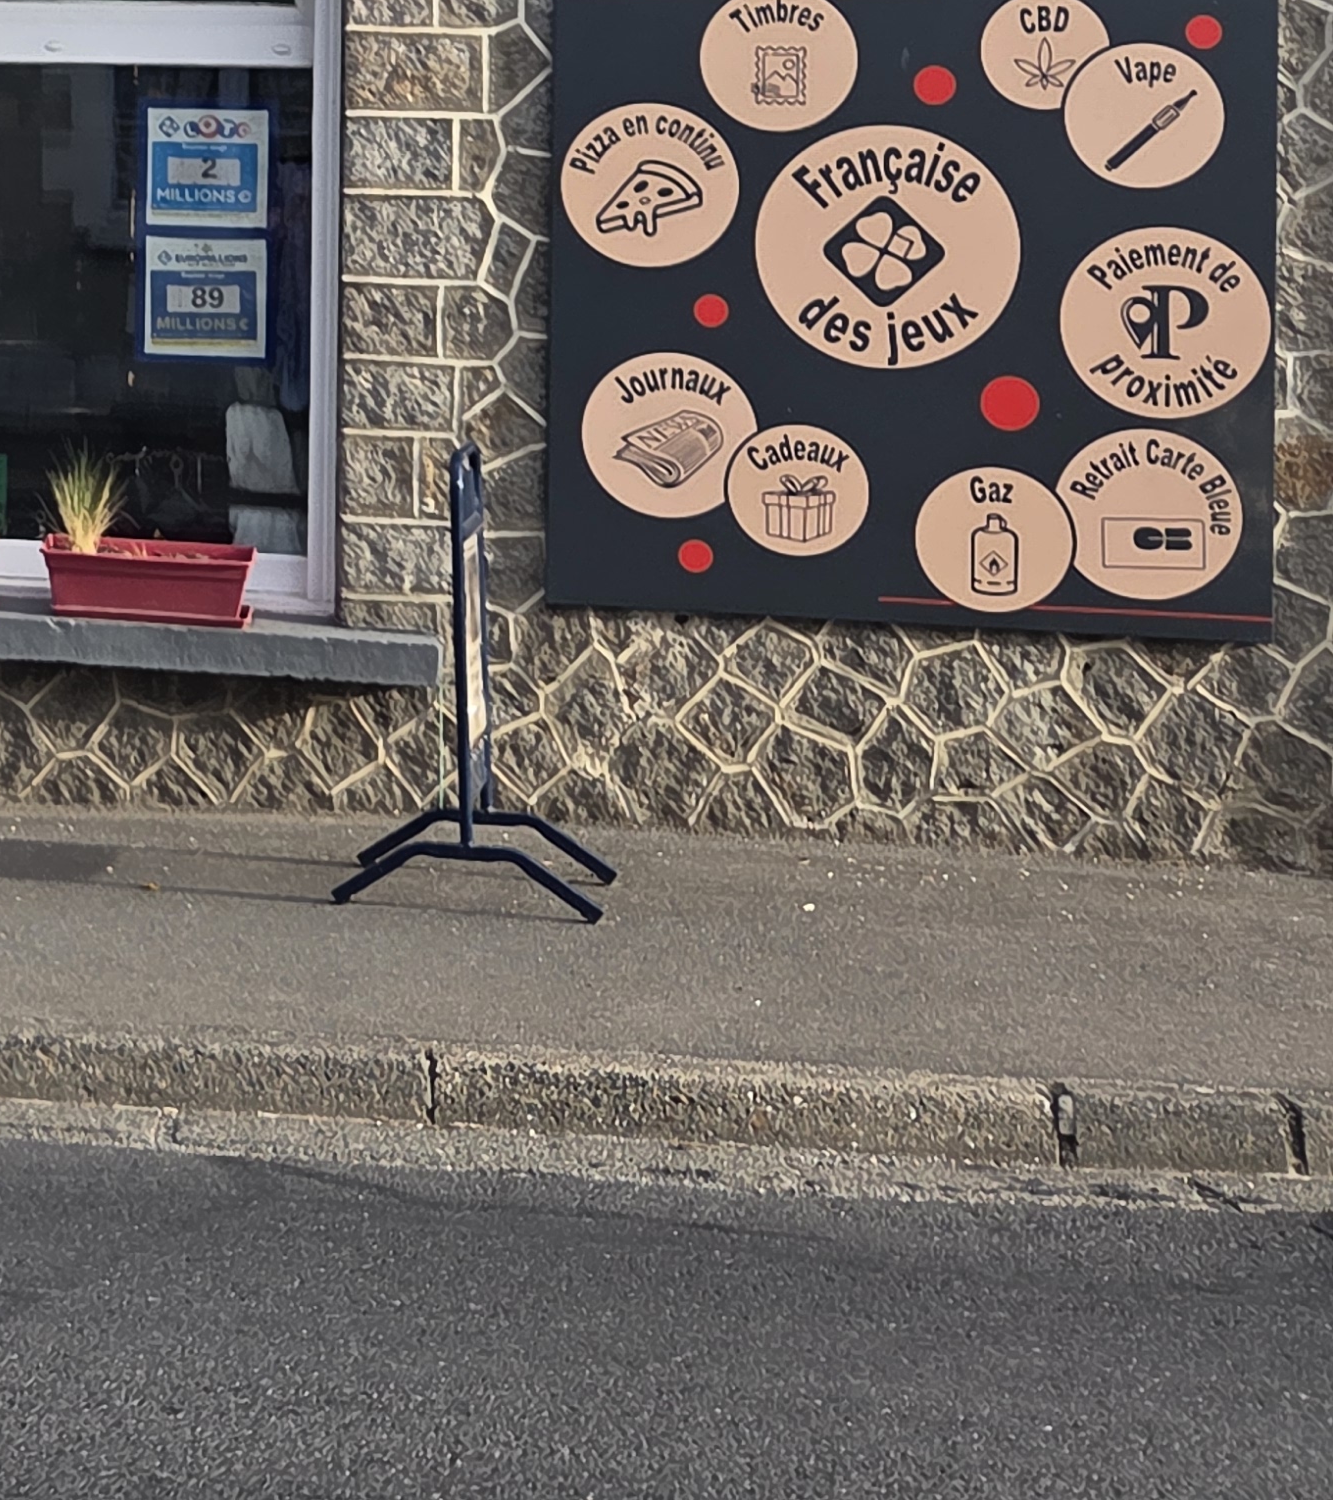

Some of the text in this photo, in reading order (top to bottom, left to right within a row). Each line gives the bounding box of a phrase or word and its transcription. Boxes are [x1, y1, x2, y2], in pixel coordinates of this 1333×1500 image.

[1018, 5, 1070, 35] CBD
[1114, 56, 1177, 85] Vape
[569, 114, 726, 175] Pizza en continu
[201, 156, 218, 180] 2
[790, 142, 983, 208] Française
[156, 187, 236, 204] MILLIONS
[1086, 243, 1241, 293] Paiement de
[191, 285, 225, 309] 89
[156, 316, 237, 331] MILLIONS
[797, 292, 980, 366] des jeux
[614, 367, 732, 406] Journaux
[1089, 354, 1239, 408] proximité
[746, 437, 851, 474] Cadeaux
[969, 475, 1015, 504] Gaz
[1069, 438, 1233, 537] Retrait Carte Bleue
